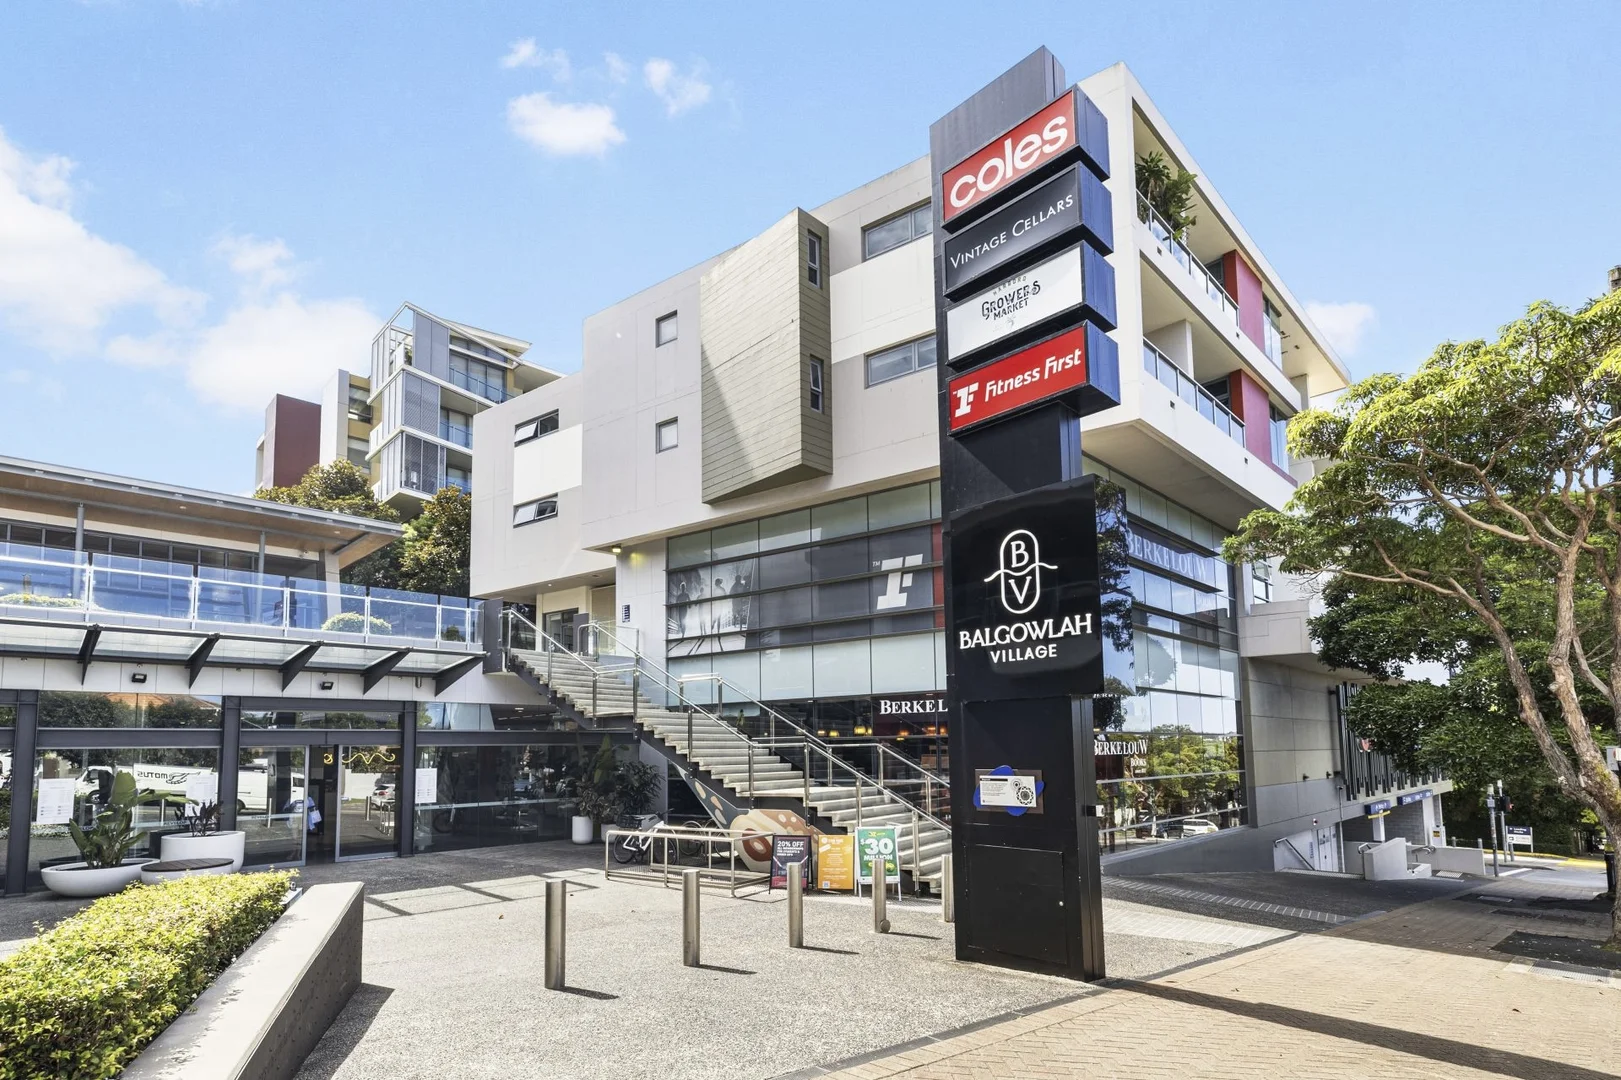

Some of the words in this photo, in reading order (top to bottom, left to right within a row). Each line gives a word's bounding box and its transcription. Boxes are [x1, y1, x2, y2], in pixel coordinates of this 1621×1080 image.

[949, 115, 1068, 208] coles
[950, 232, 1007, 269] VINTAGE
[1012, 194, 1074, 237] CELLARS
[981, 280, 1041, 320] GROWERS
[993, 297, 1029, 320] MARKET
[984, 367, 1041, 402] Fitness
[1044, 348, 1082, 380] First
[1010, 540, 1028, 568] B
[1008, 576, 1031, 605] V
[959, 613, 1092, 650] BALGOWLAH
[990, 643, 1058, 664] VILLAGE
[860, 838, 894, 855] $30
